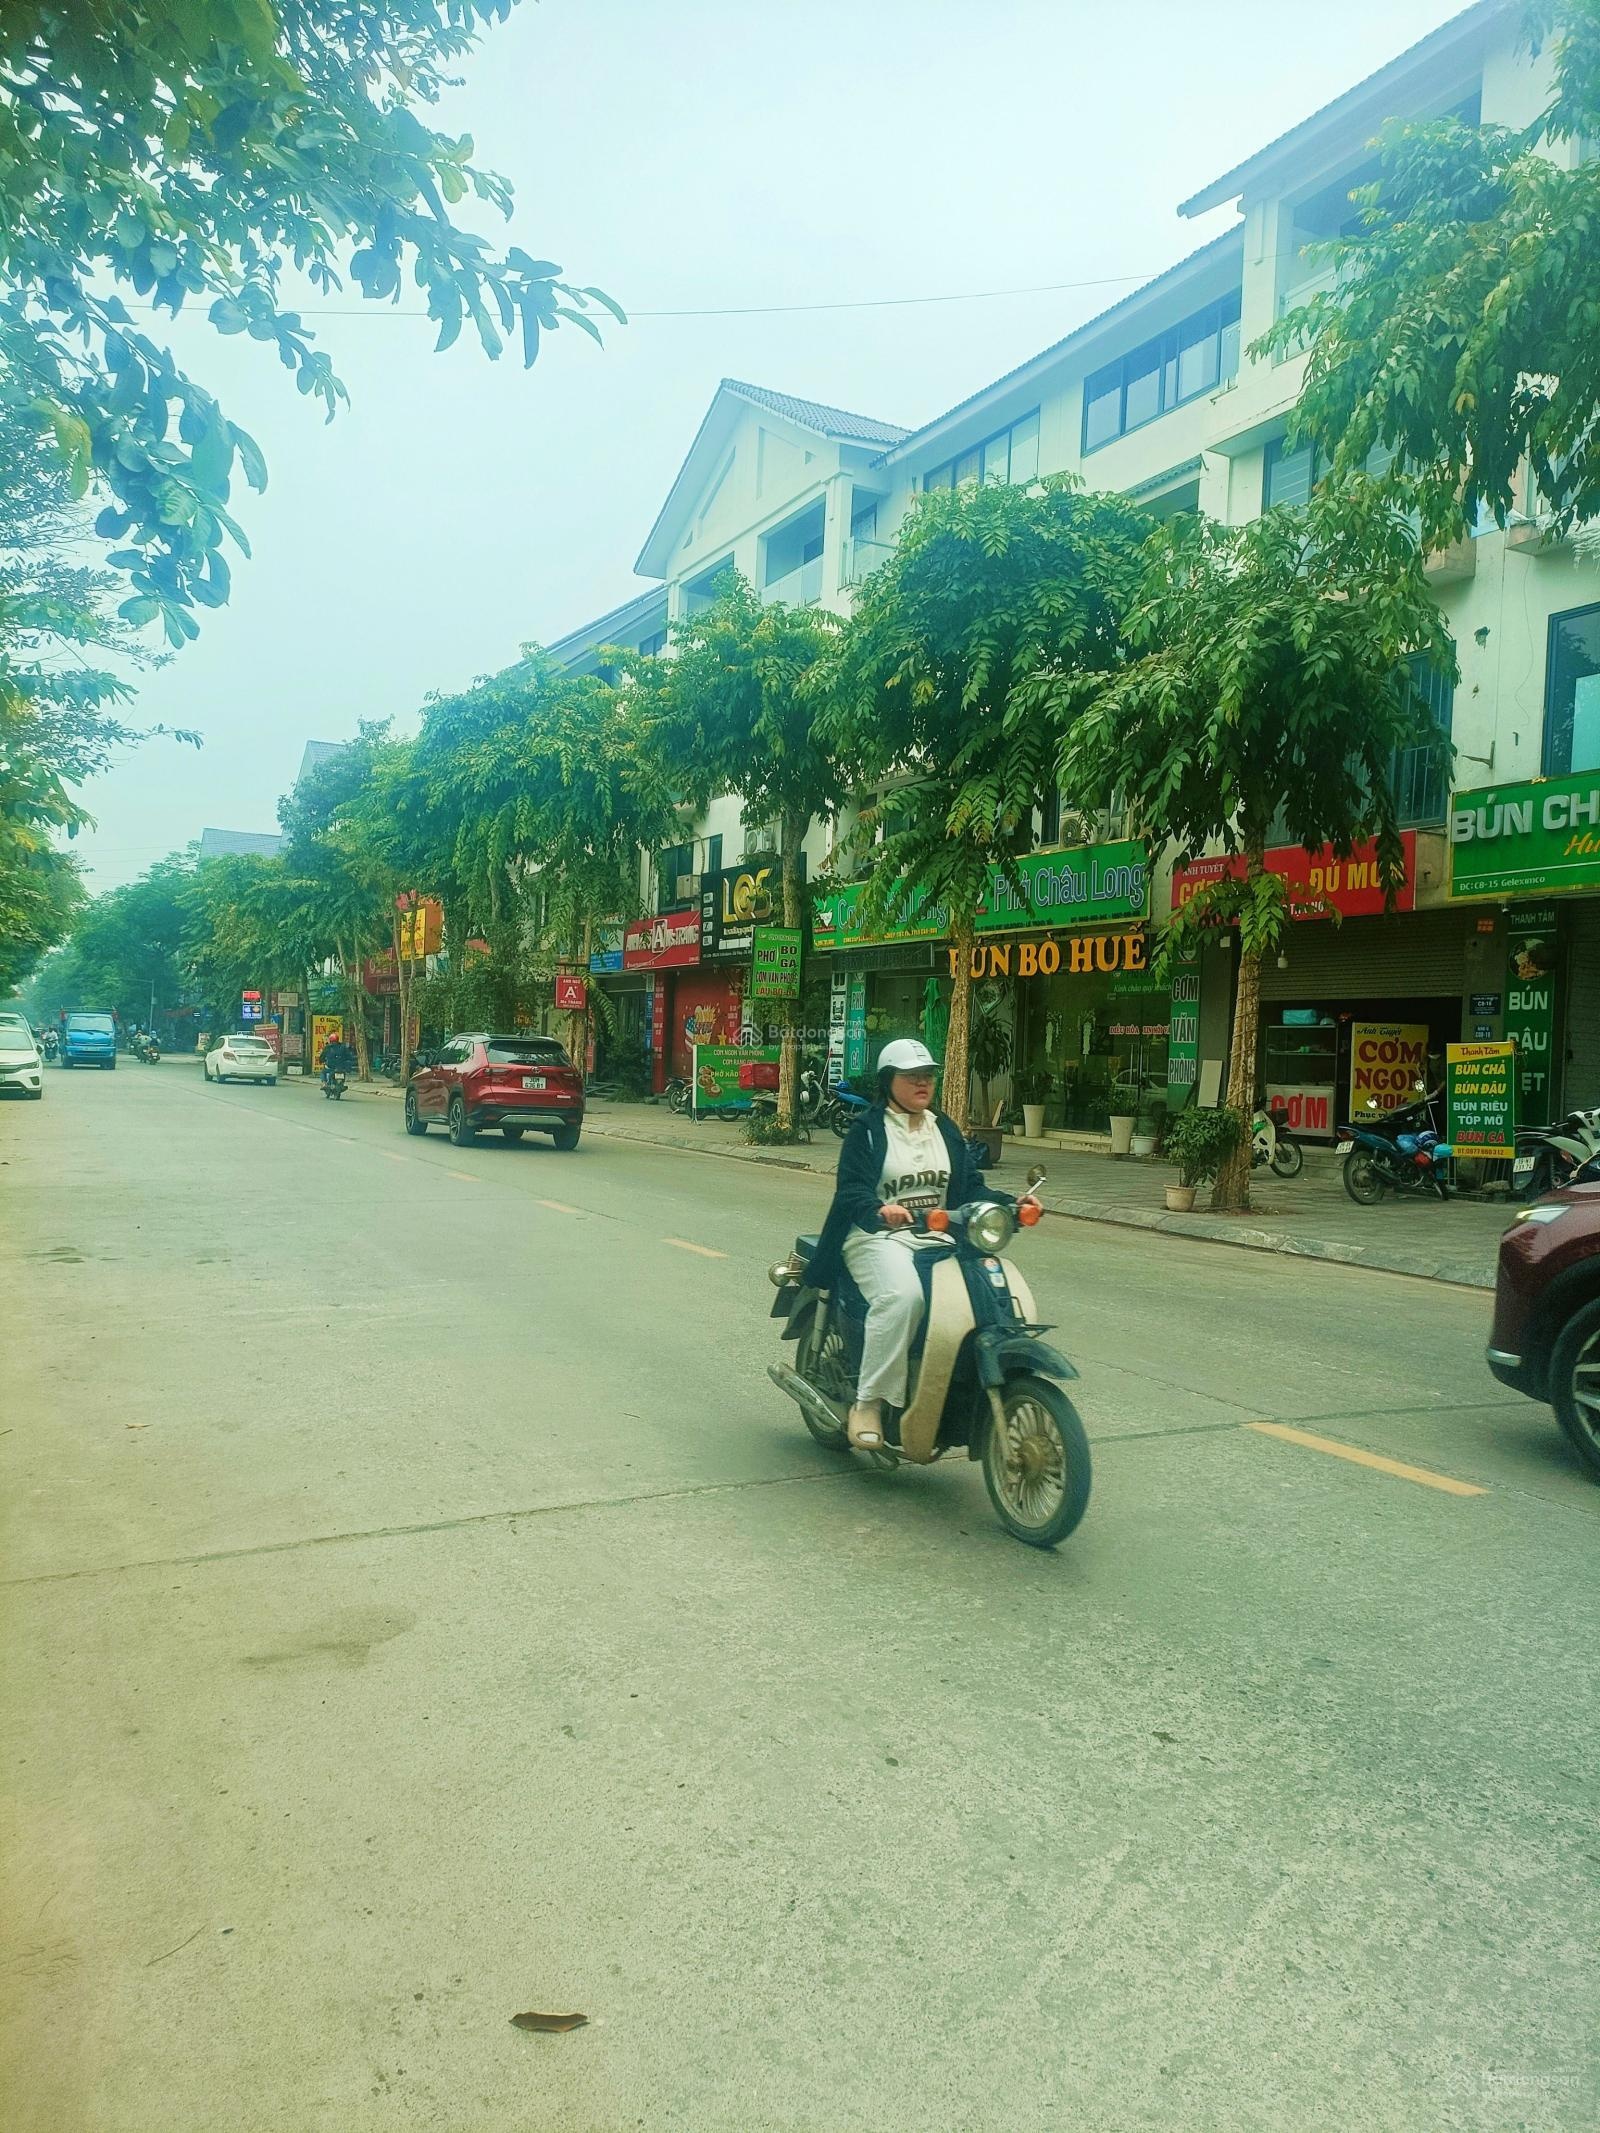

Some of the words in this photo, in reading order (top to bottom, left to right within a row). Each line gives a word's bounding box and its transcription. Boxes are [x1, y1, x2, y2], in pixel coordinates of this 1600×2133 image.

[1451, 793, 1534, 843] BÚN
[1542, 789, 1600, 831] CH
[1035, 864, 1088, 907] Châu
[1091, 859, 1146, 909] Long
[1510, 913, 1536, 925] THANH
[1538, 909, 1556, 923] TÂM
[757, 946, 776, 963] PHỞ
[780, 943, 798, 955] BÒ
[1018, 931, 1061, 977] BÒ
[1069, 921, 1147, 974] HUẾ
[1172, 975, 1200, 1002] CƠM
[1508, 985, 1549, 1011] BÚN
[1172, 1012, 1198, 1043] VĂN
[1358, 1036, 1424, 1065] CƠM
[1168, 1053, 1197, 1085] PHÒNG
[1455, 1062, 1480, 1075] BÚN
[1482, 1060, 1506, 1075] CHẢ
[1454, 1080, 1479, 1095] BÚN
[1480, 1082, 1507, 1098] ĐẬU
[1521, 1071, 1546, 1096] ẸT
[1354, 1110, 1376, 1120] Phục
[1453, 1099, 1477, 1112] BÚN
[1456, 1128, 1485, 1143] BÚN
[883, 1169, 949, 1200] NAME
